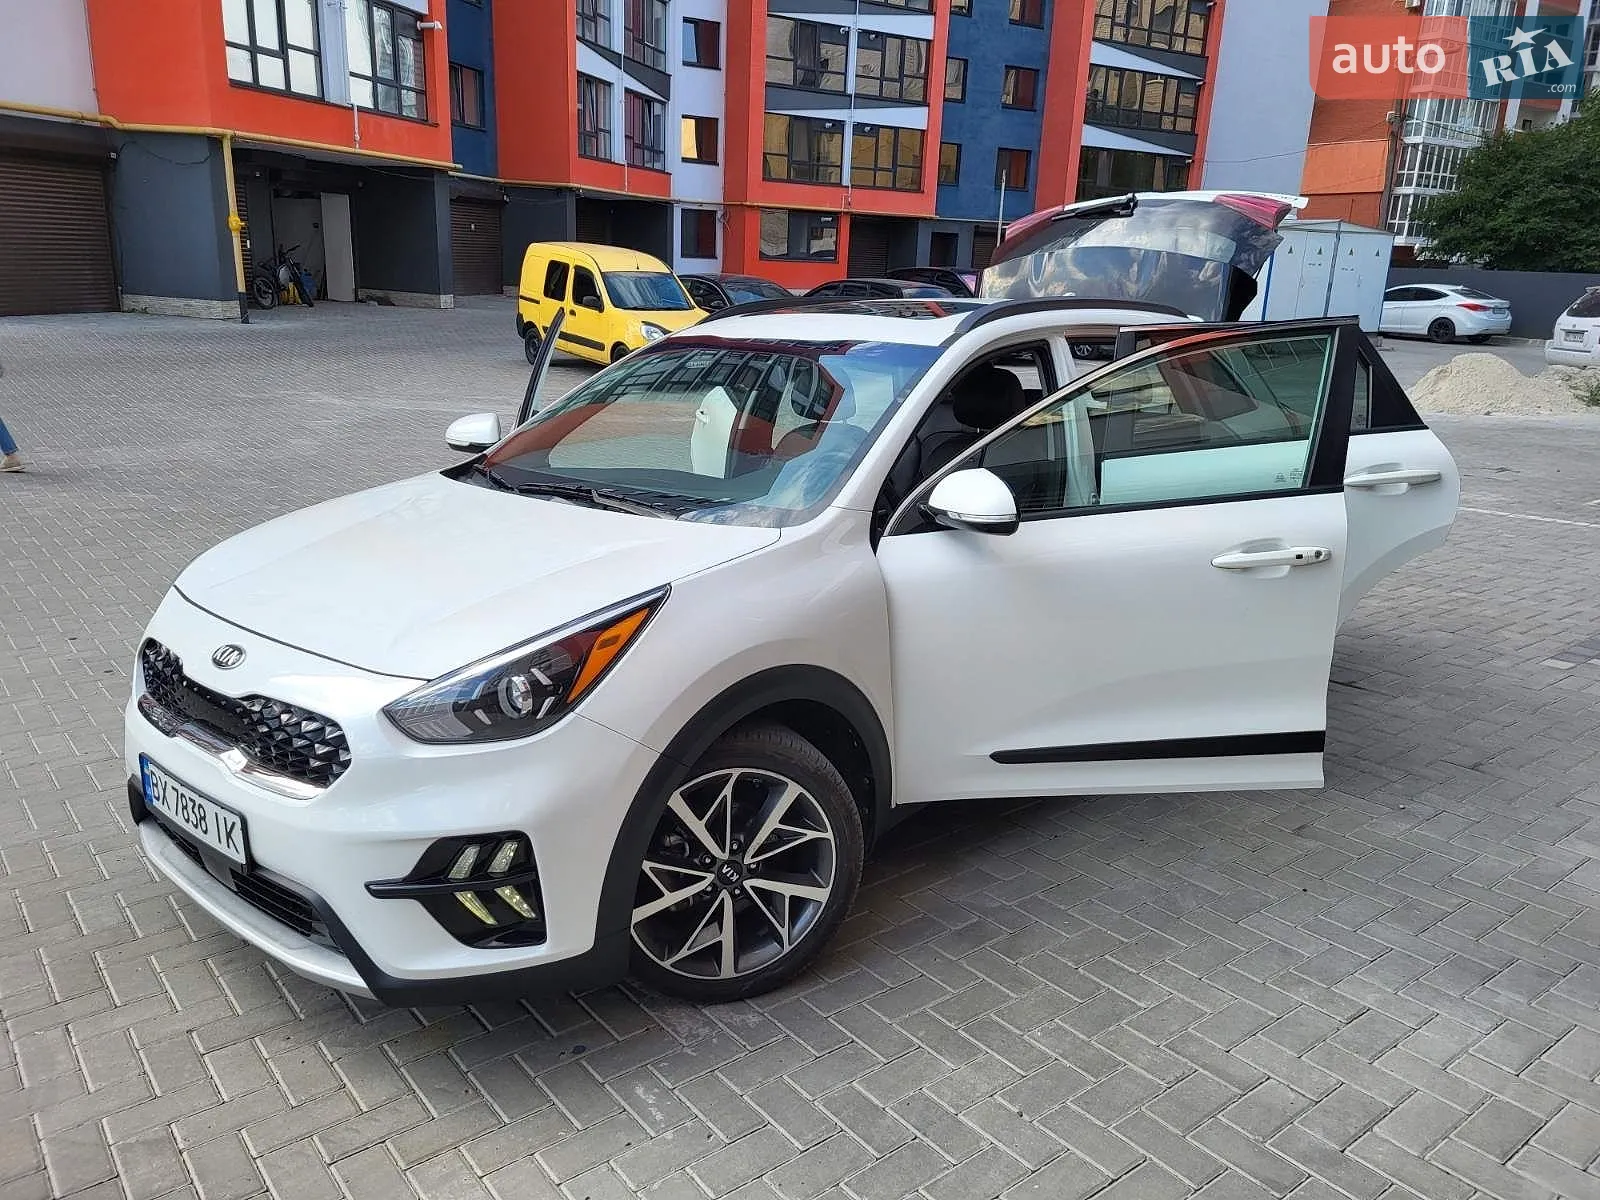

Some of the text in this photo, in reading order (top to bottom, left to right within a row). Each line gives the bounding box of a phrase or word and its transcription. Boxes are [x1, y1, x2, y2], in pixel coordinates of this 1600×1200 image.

[212, 645, 243, 667] KIA
[150, 769, 171, 812] BX
[171, 786, 208, 835] 7838
[214, 811, 240, 855] IK
[721, 864, 740, 882] KIA
